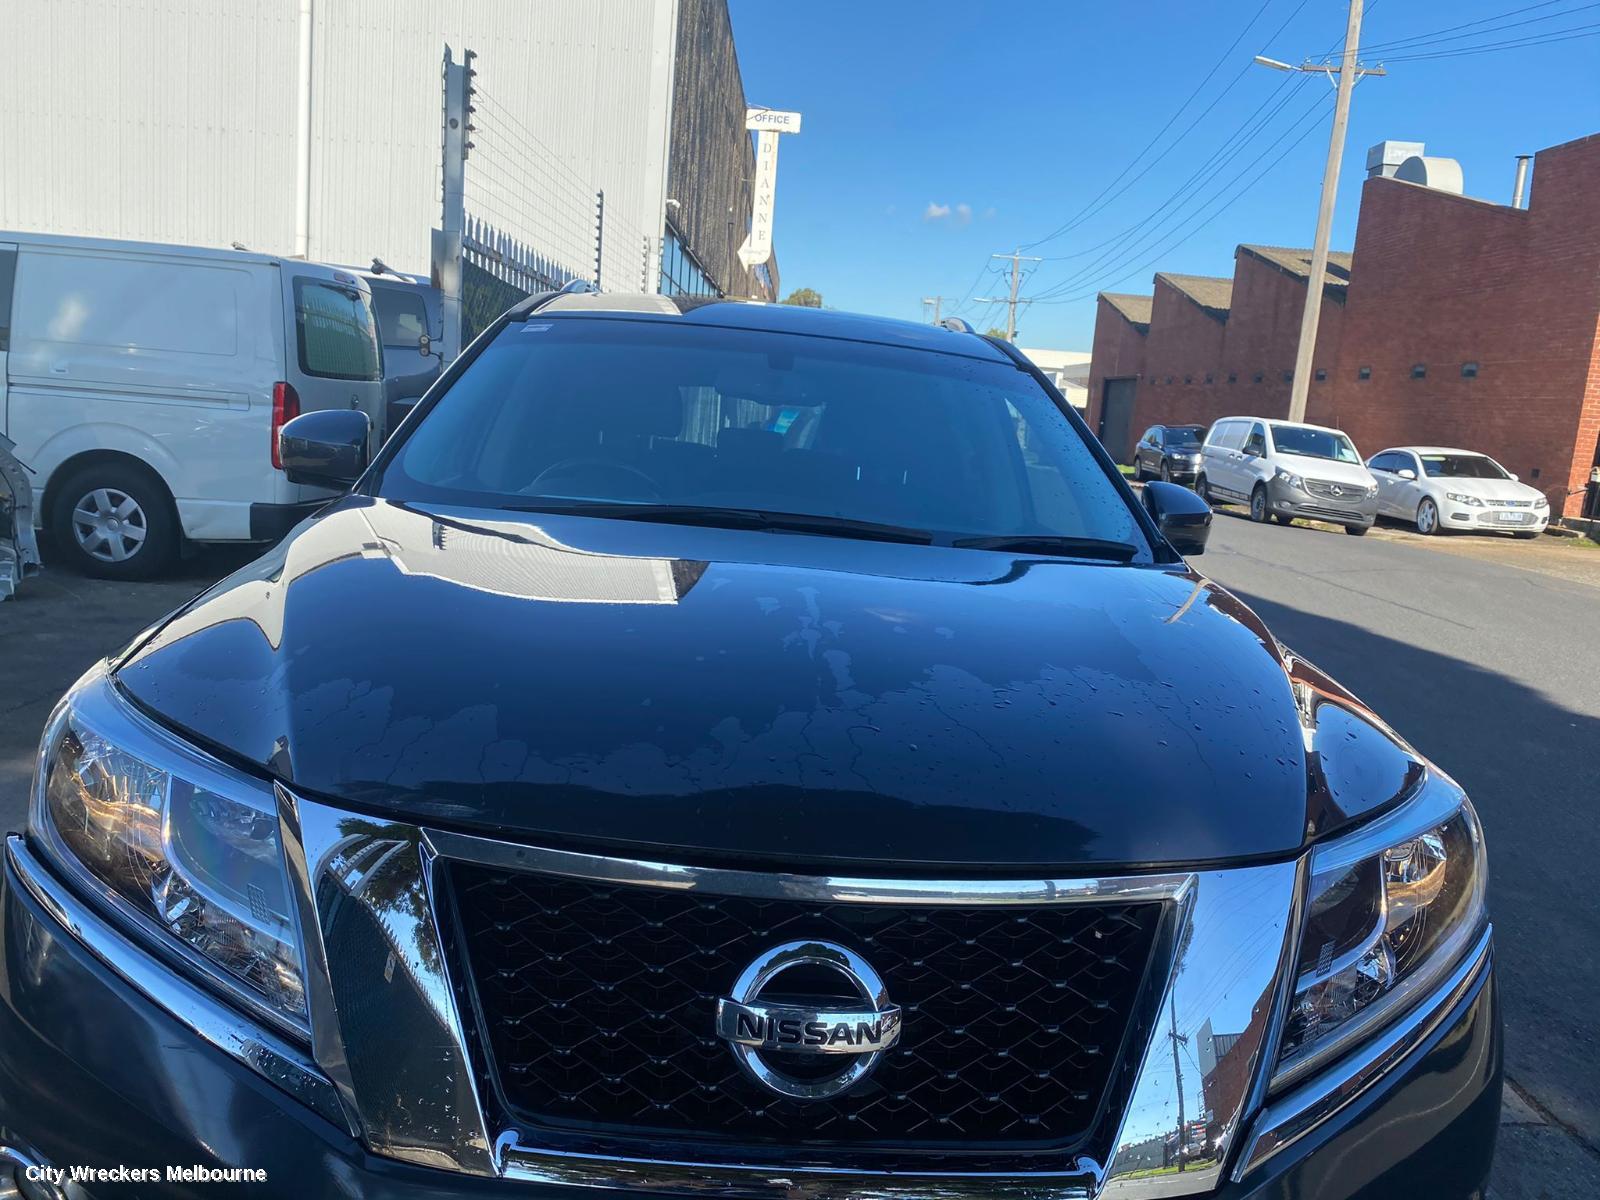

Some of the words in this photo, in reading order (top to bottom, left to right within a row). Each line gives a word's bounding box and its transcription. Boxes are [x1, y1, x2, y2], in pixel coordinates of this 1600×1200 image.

[754, 113, 790, 125] OFFICE
[758, 143, 772, 241] DIANNE
[736, 1013, 883, 1046] NISSAN
